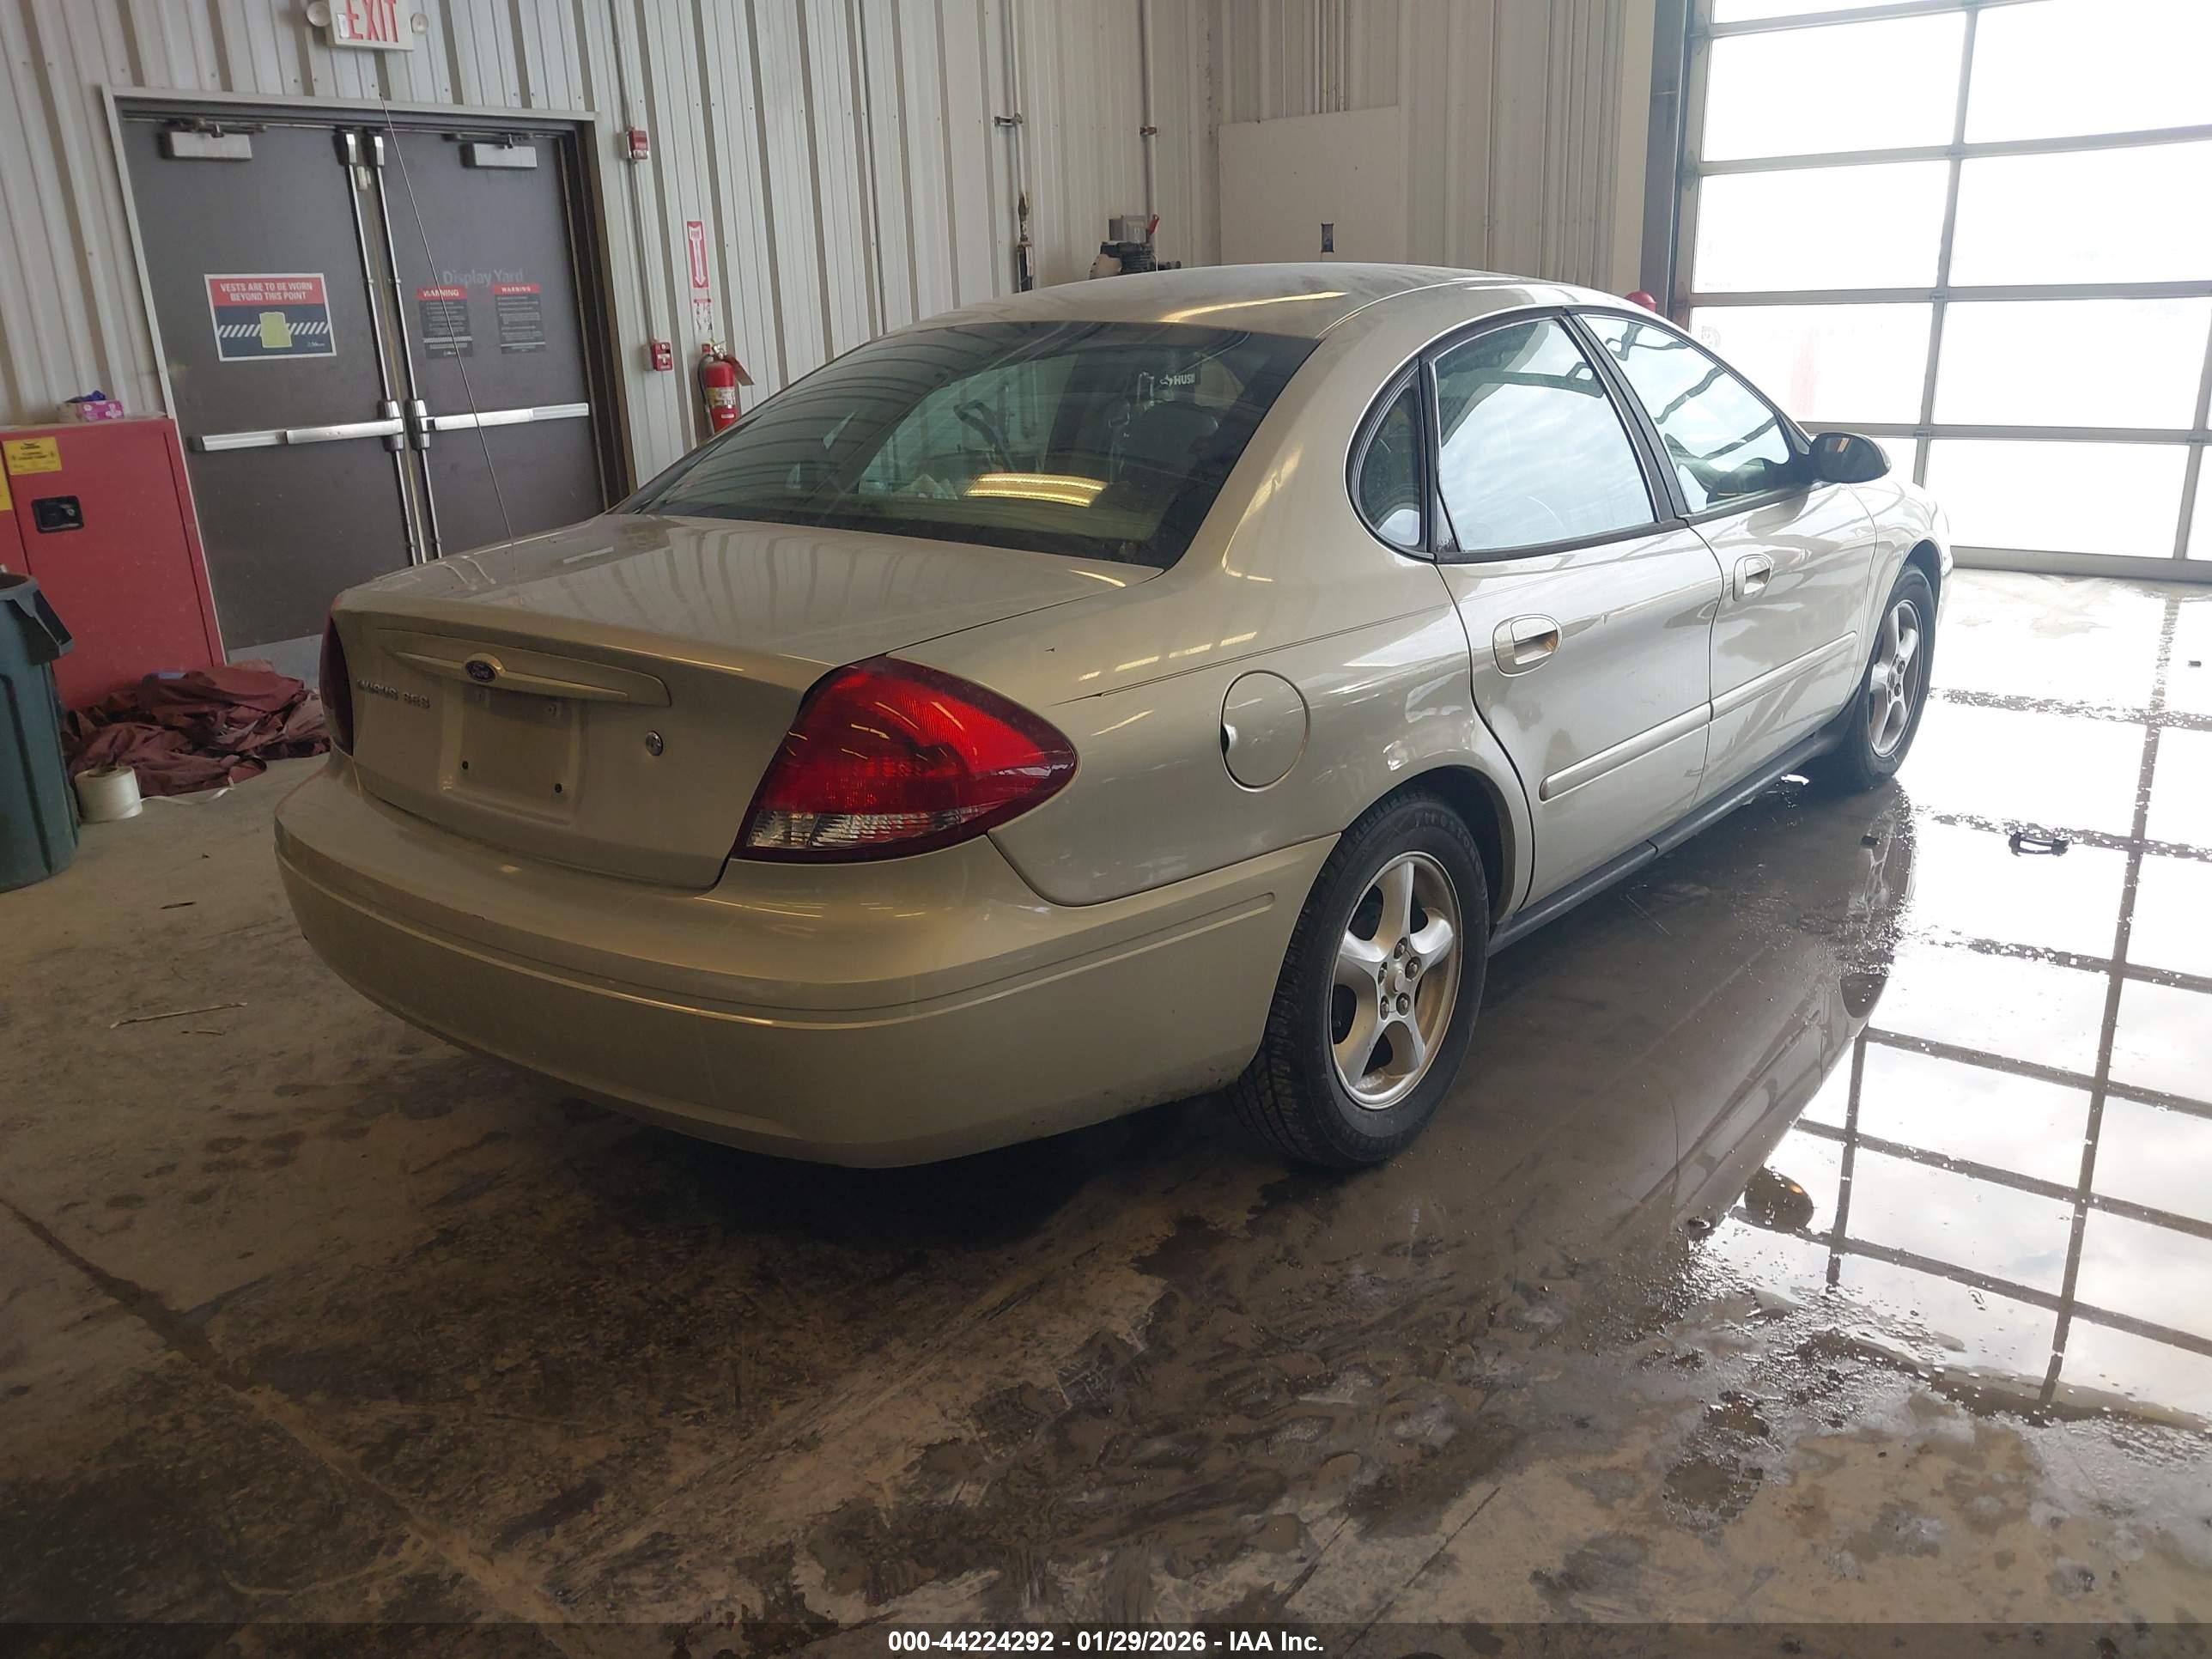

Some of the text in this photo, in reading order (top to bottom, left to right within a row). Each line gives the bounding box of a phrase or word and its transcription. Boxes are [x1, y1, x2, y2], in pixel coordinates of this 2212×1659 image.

[344, 0, 398, 42] EXIT
[443, 267, 524, 287] Display Yard
[220, 281, 313, 293] VESTS ARE TO BE WORN
[230, 290, 307, 301] BEYOND THIS POINT
[422, 289, 459, 298] WARNING
